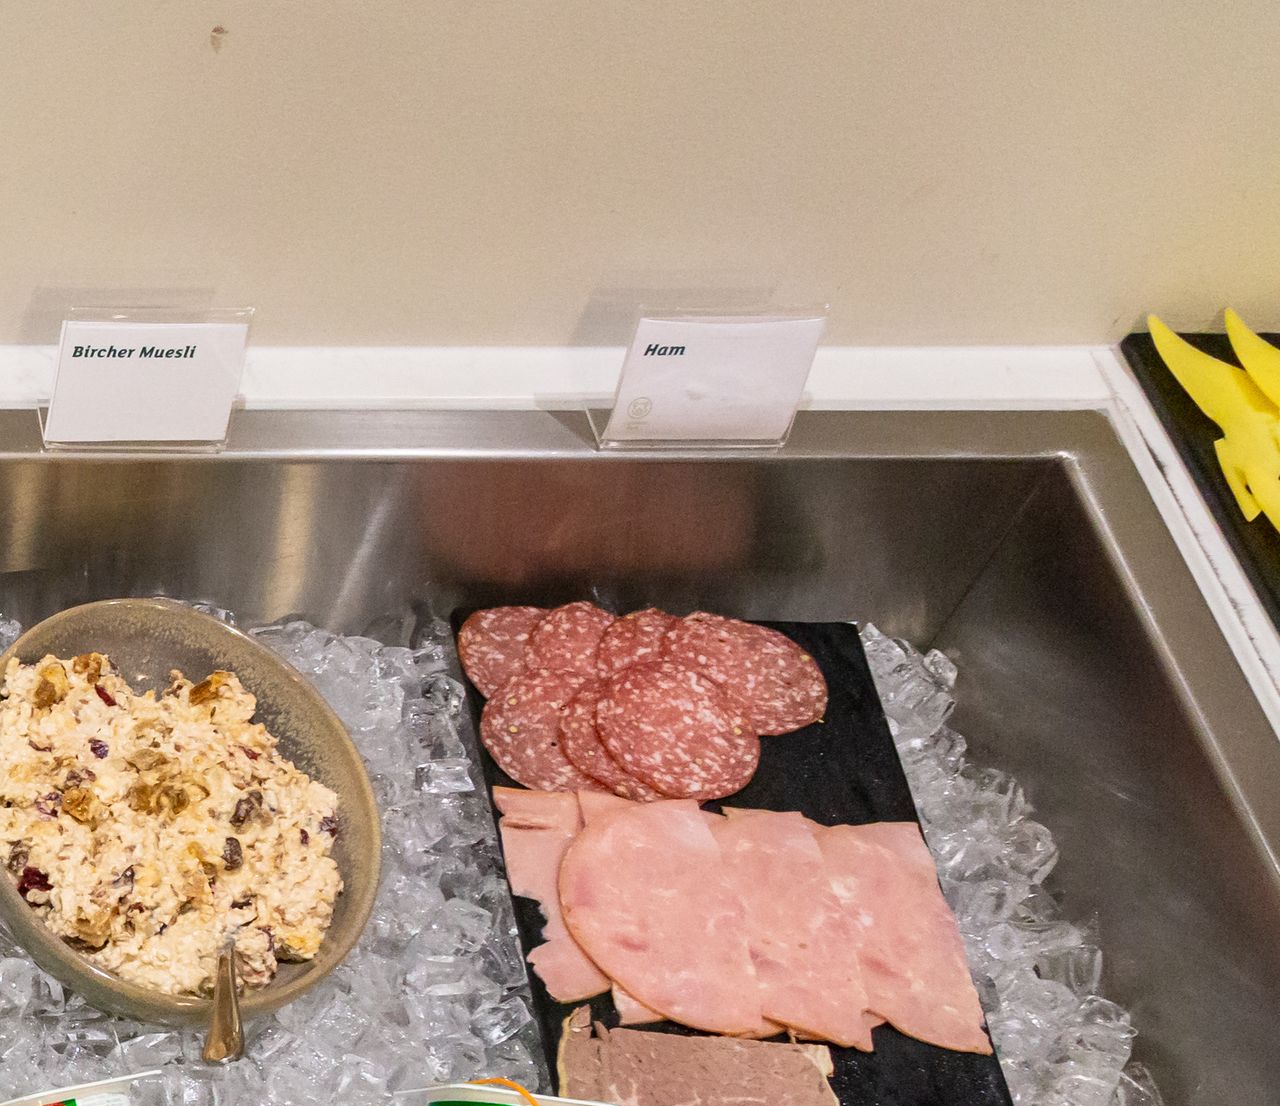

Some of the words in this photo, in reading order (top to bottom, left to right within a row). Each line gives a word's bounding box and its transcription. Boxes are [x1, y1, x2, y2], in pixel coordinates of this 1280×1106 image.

[72, 345, 135, 358] Bircher
[139, 345, 197, 358] Muesli
[643, 344, 686, 356] Ham
